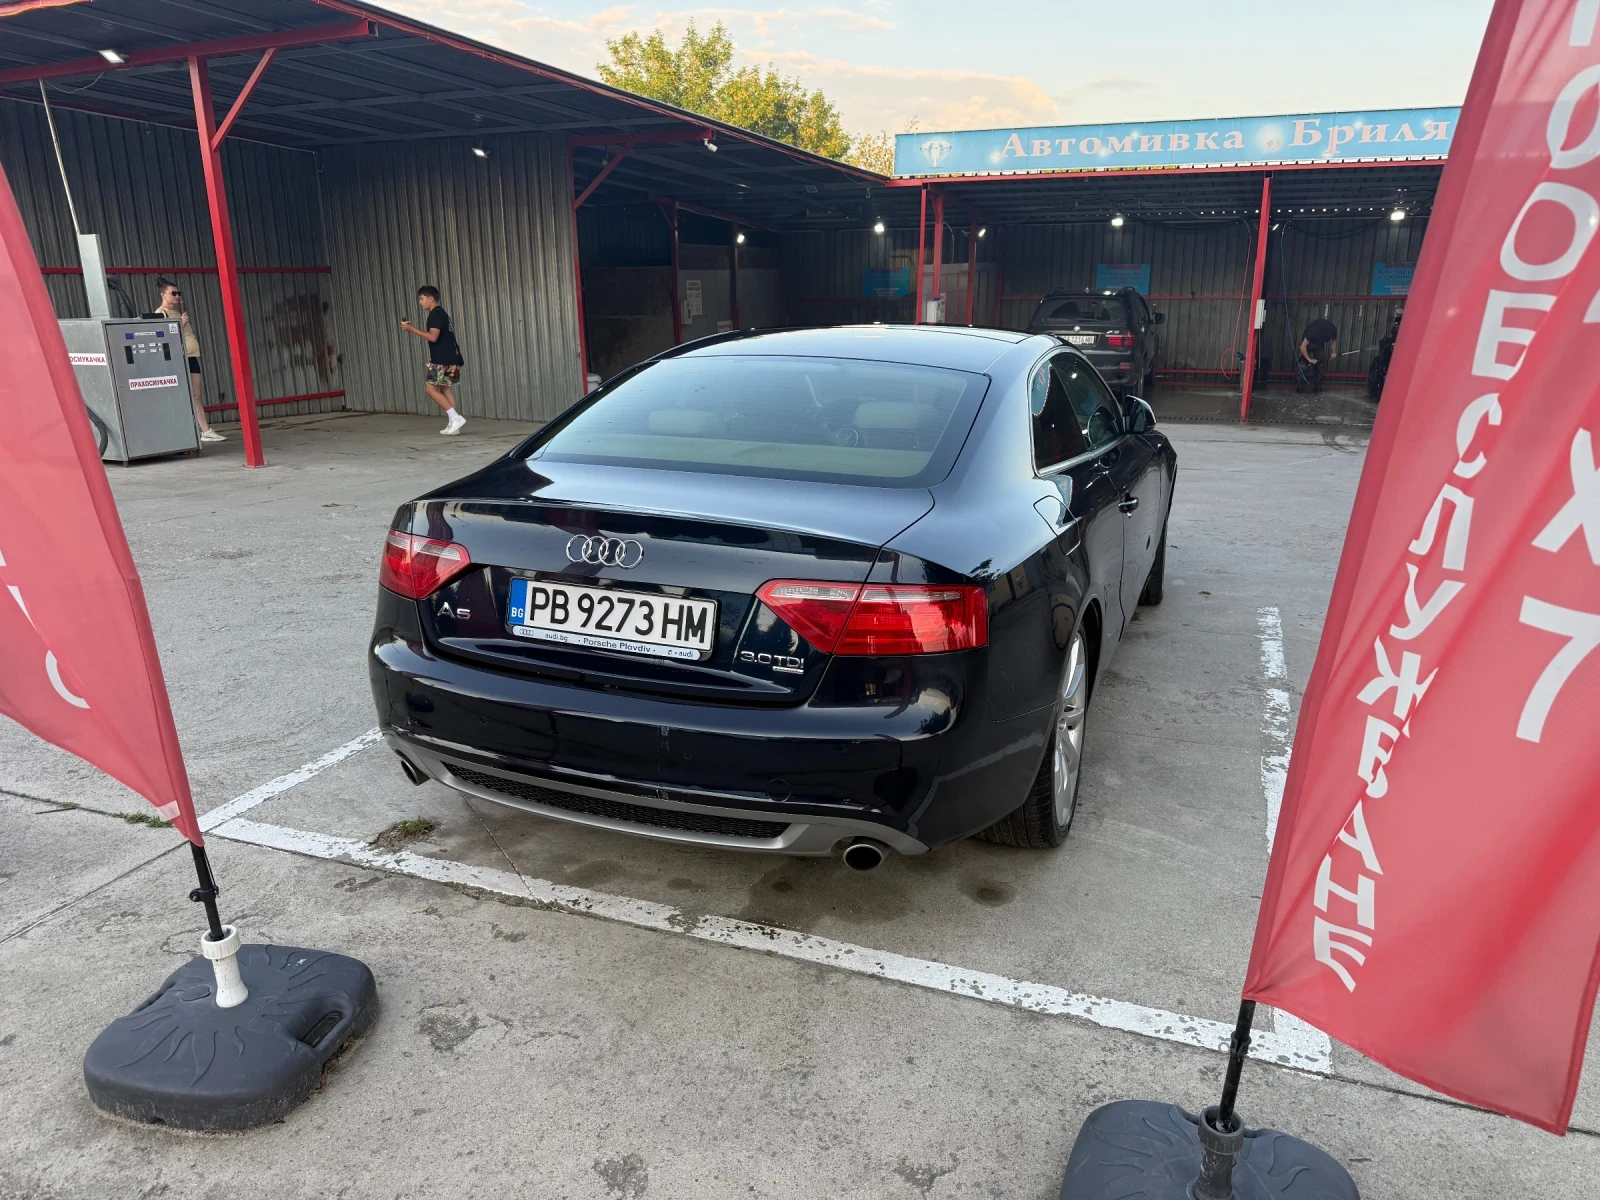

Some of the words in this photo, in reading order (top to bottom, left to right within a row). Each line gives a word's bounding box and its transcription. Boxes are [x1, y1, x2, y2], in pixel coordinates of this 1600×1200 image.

[999, 130, 1244, 158] Автомивка
[1263, 118, 1451, 156] „Бриля
[130, 378, 177, 389] ПРАХОСМУКАЧКА
[437, 601, 471, 620] A5
[511, 607, 524, 618] BG
[529, 586, 570, 625] PB
[577, 592, 654, 636] 9273
[661, 602, 708, 644] HM
[544, 632, 568, 643] audi.bg
[583, 638, 617, 649] Porsche
[619, 642, 651, 653] Plovdiv
[740, 650, 772, 664] 3.0
[774, 655, 805, 669] TDI
